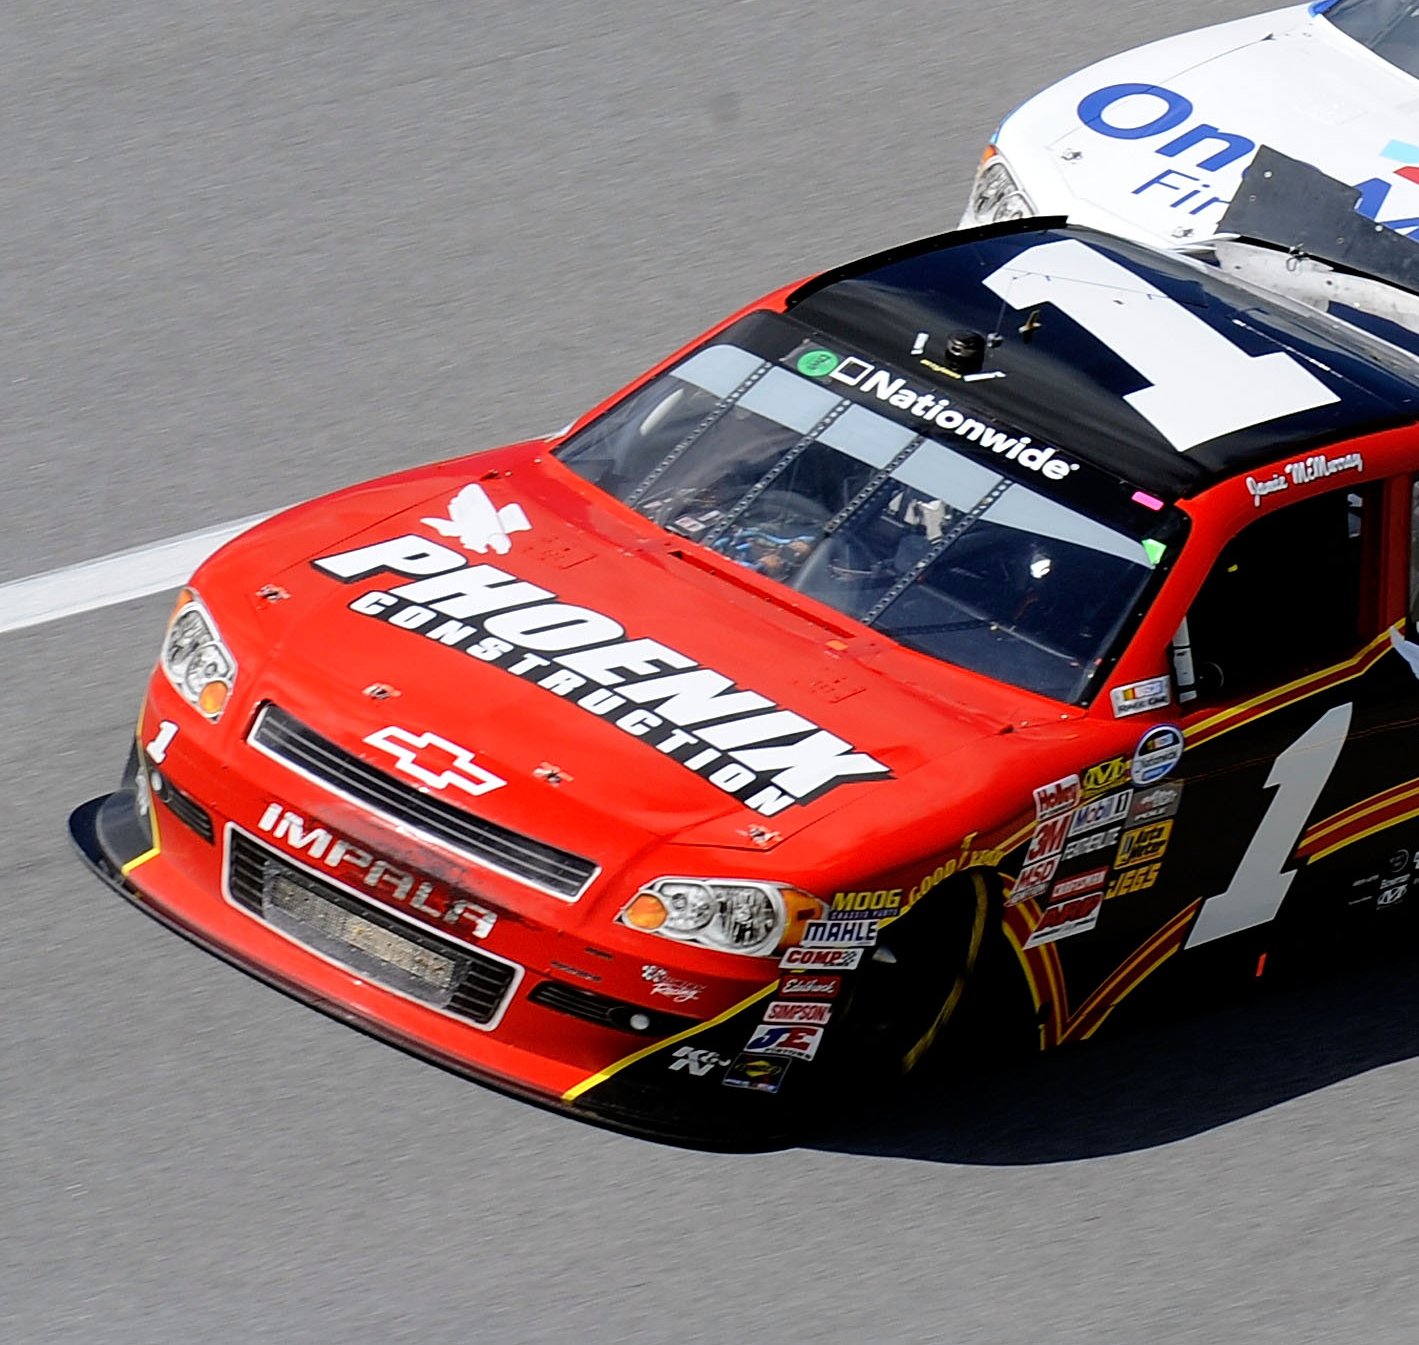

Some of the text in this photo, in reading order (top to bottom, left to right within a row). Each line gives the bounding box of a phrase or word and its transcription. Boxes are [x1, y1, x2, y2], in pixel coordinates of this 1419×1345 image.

[981, 239, 1341, 452] 1
[861, 370, 1071, 481] Nationwide
[1245, 473, 1289, 507] Jamie
[312, 533, 895, 802] PHOENIX
[348, 589, 801, 817] CONSTRUCTION
[145, 719, 180, 765] 1
[1114, 789, 1130, 815] 1
[1027, 811, 1072, 862] 3M
[1184, 701, 1354, 951] 1
[255, 801, 499, 939] IMPALA
[1104, 861, 1163, 901] JEGS
[831, 888, 903, 912] MOOG
[803, 919, 879, 943] MAHLE
[786, 949, 845, 965] COMP
[781, 977, 838, 994] Edelbrock
[768, 1004, 831, 1022] SIMPSON
[746, 1025, 819, 1052] JE
